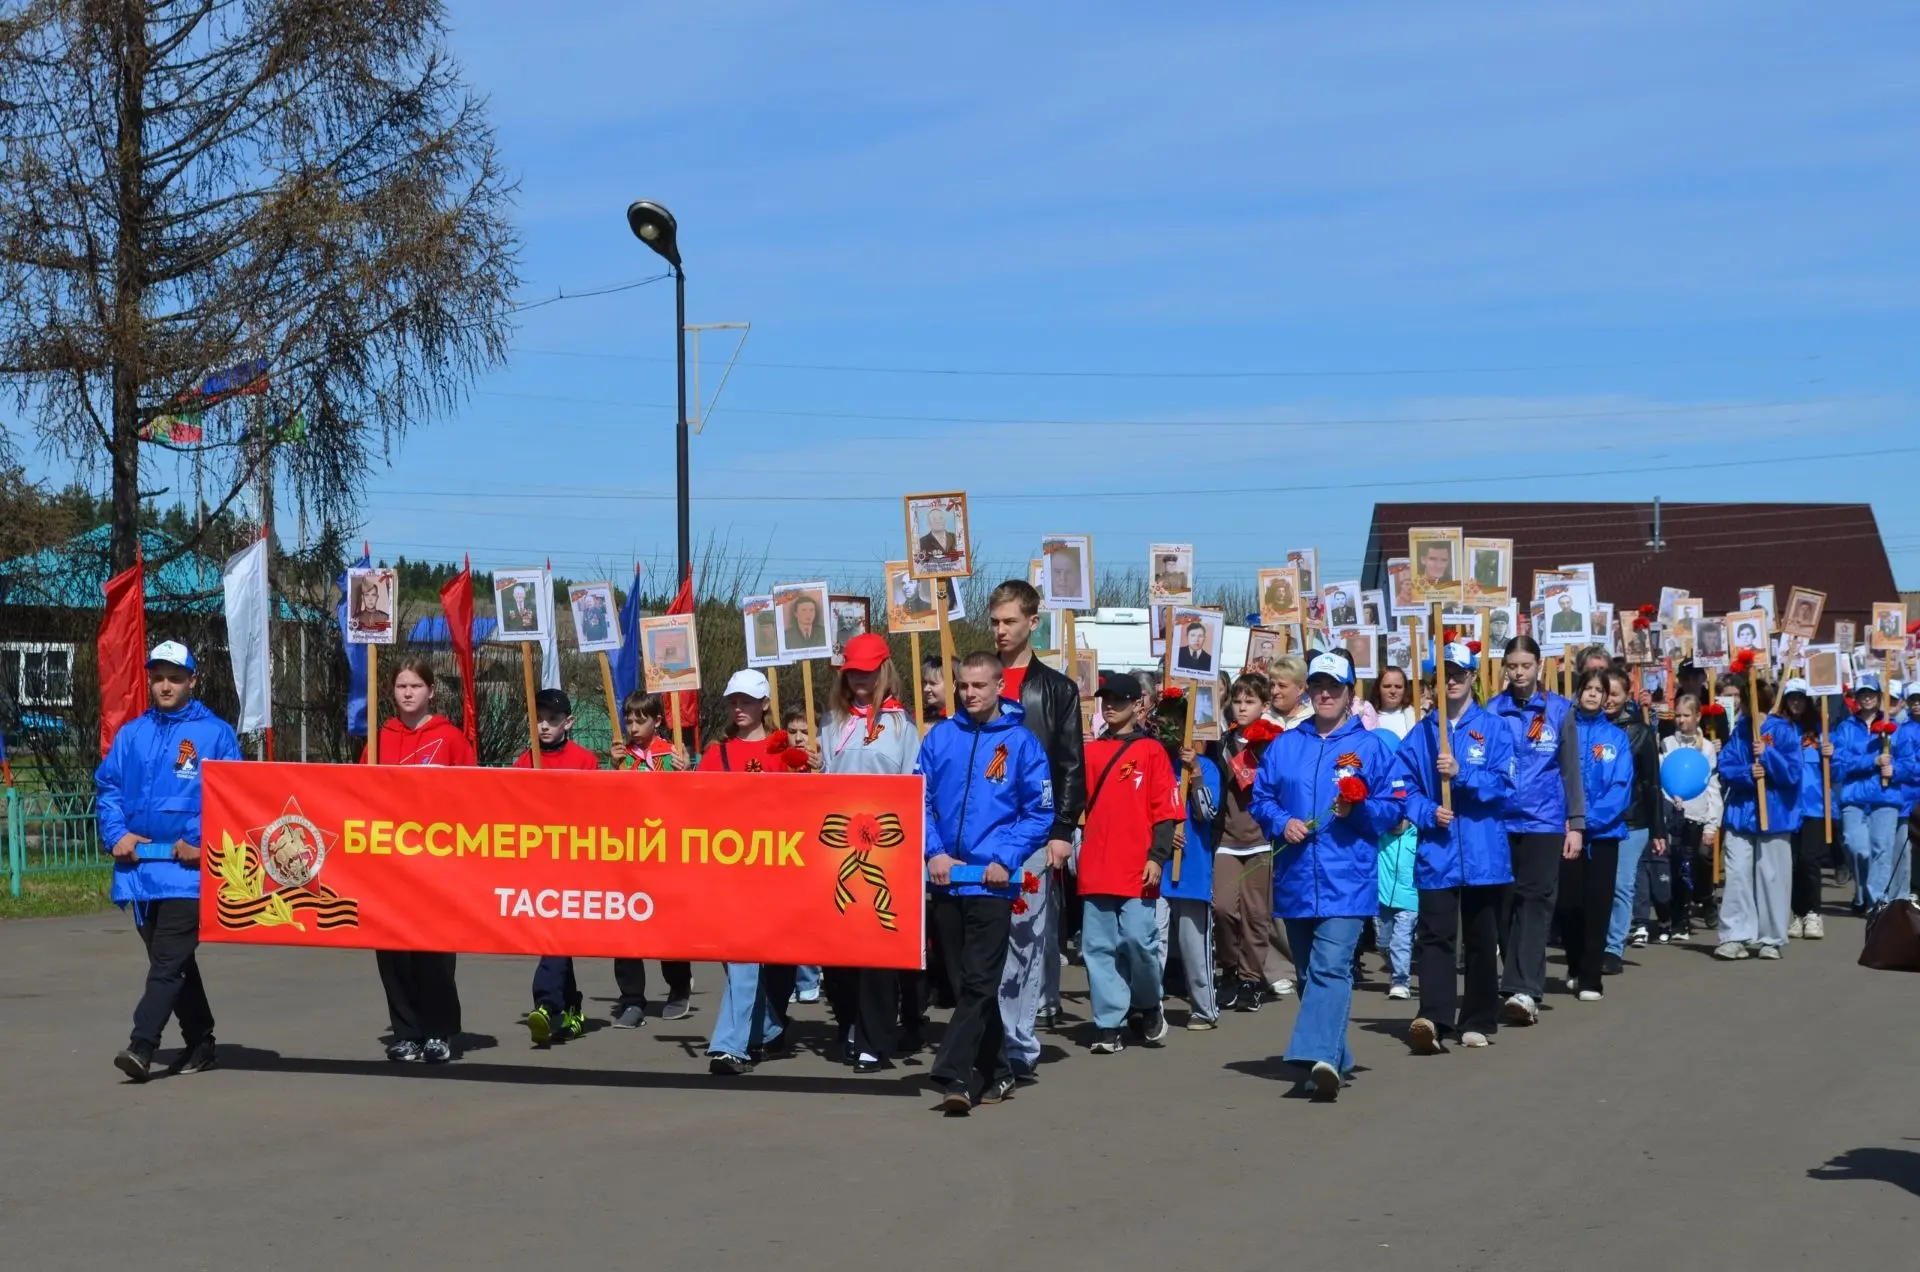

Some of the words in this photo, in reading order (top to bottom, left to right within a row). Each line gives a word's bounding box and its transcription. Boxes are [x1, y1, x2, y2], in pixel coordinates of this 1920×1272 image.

[344, 818, 666, 862] БЕССМЕРТНЫЙ
[682, 829, 804, 866] ПОЛК
[494, 888, 653, 921] ТАСЕЕВО
